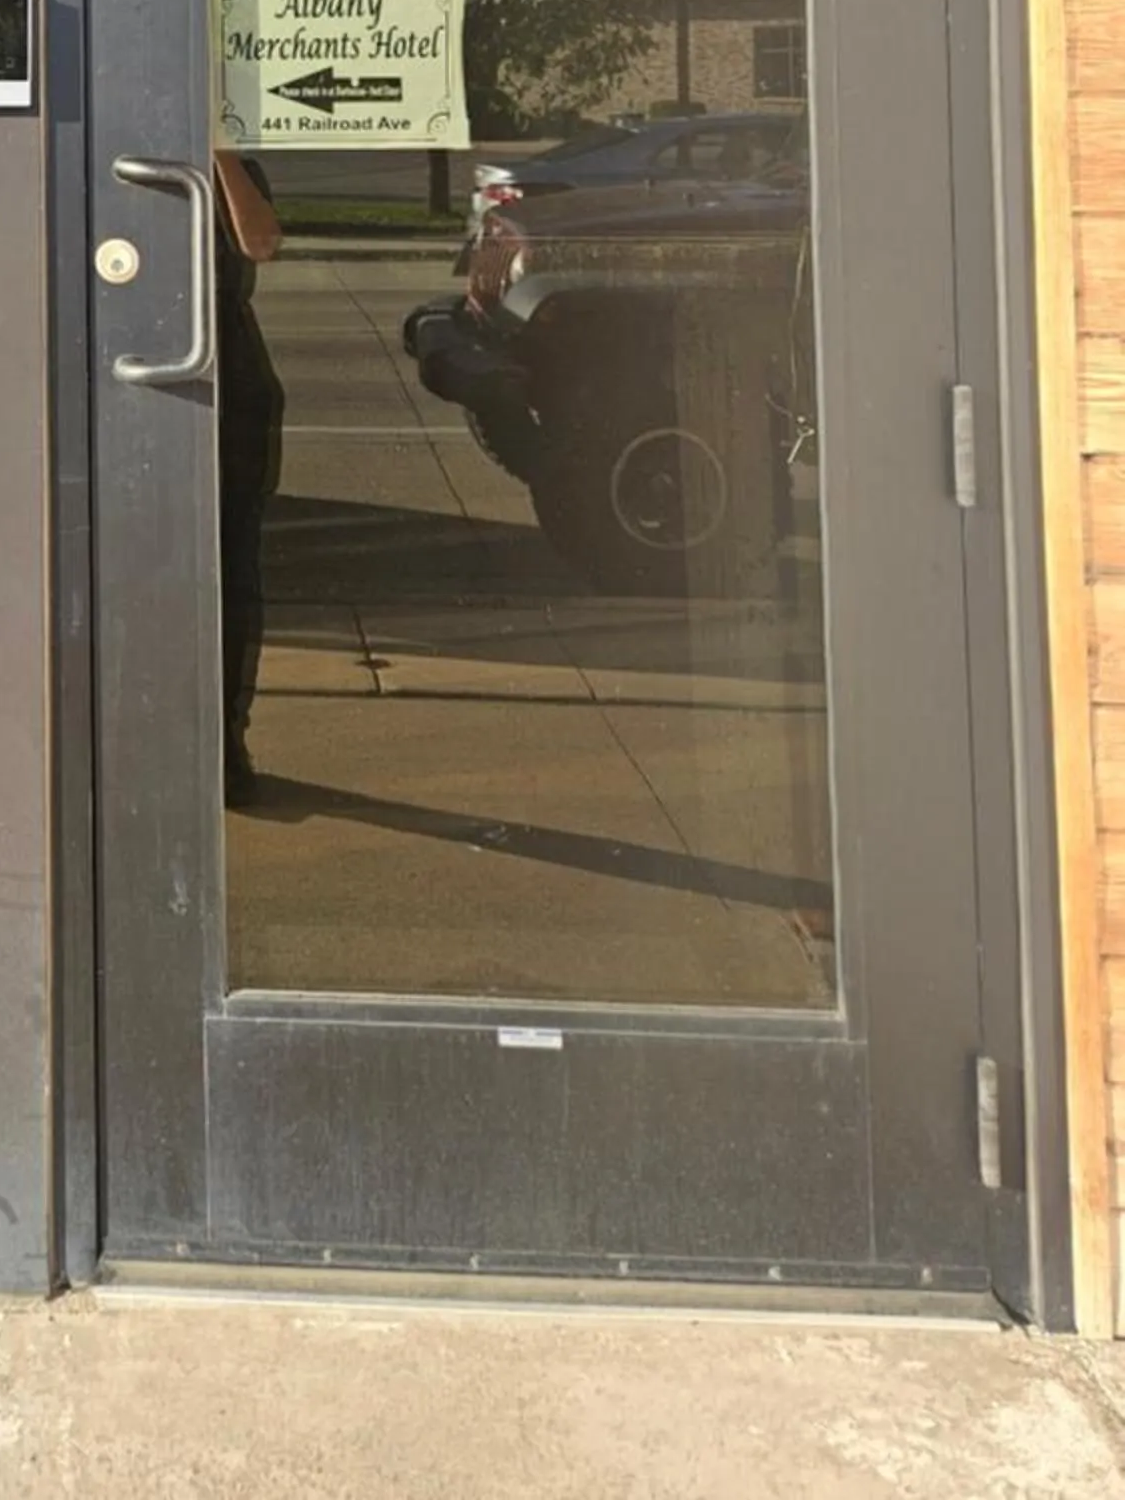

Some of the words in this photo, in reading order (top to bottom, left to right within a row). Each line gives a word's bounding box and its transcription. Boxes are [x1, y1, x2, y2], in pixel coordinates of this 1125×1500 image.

[226, 26, 361, 61] Merchants
[367, 25, 445, 59] Hotel
[262, 117, 291, 130] 441
[298, 116, 374, 131] Railroad
[377, 116, 411, 131] Ave
